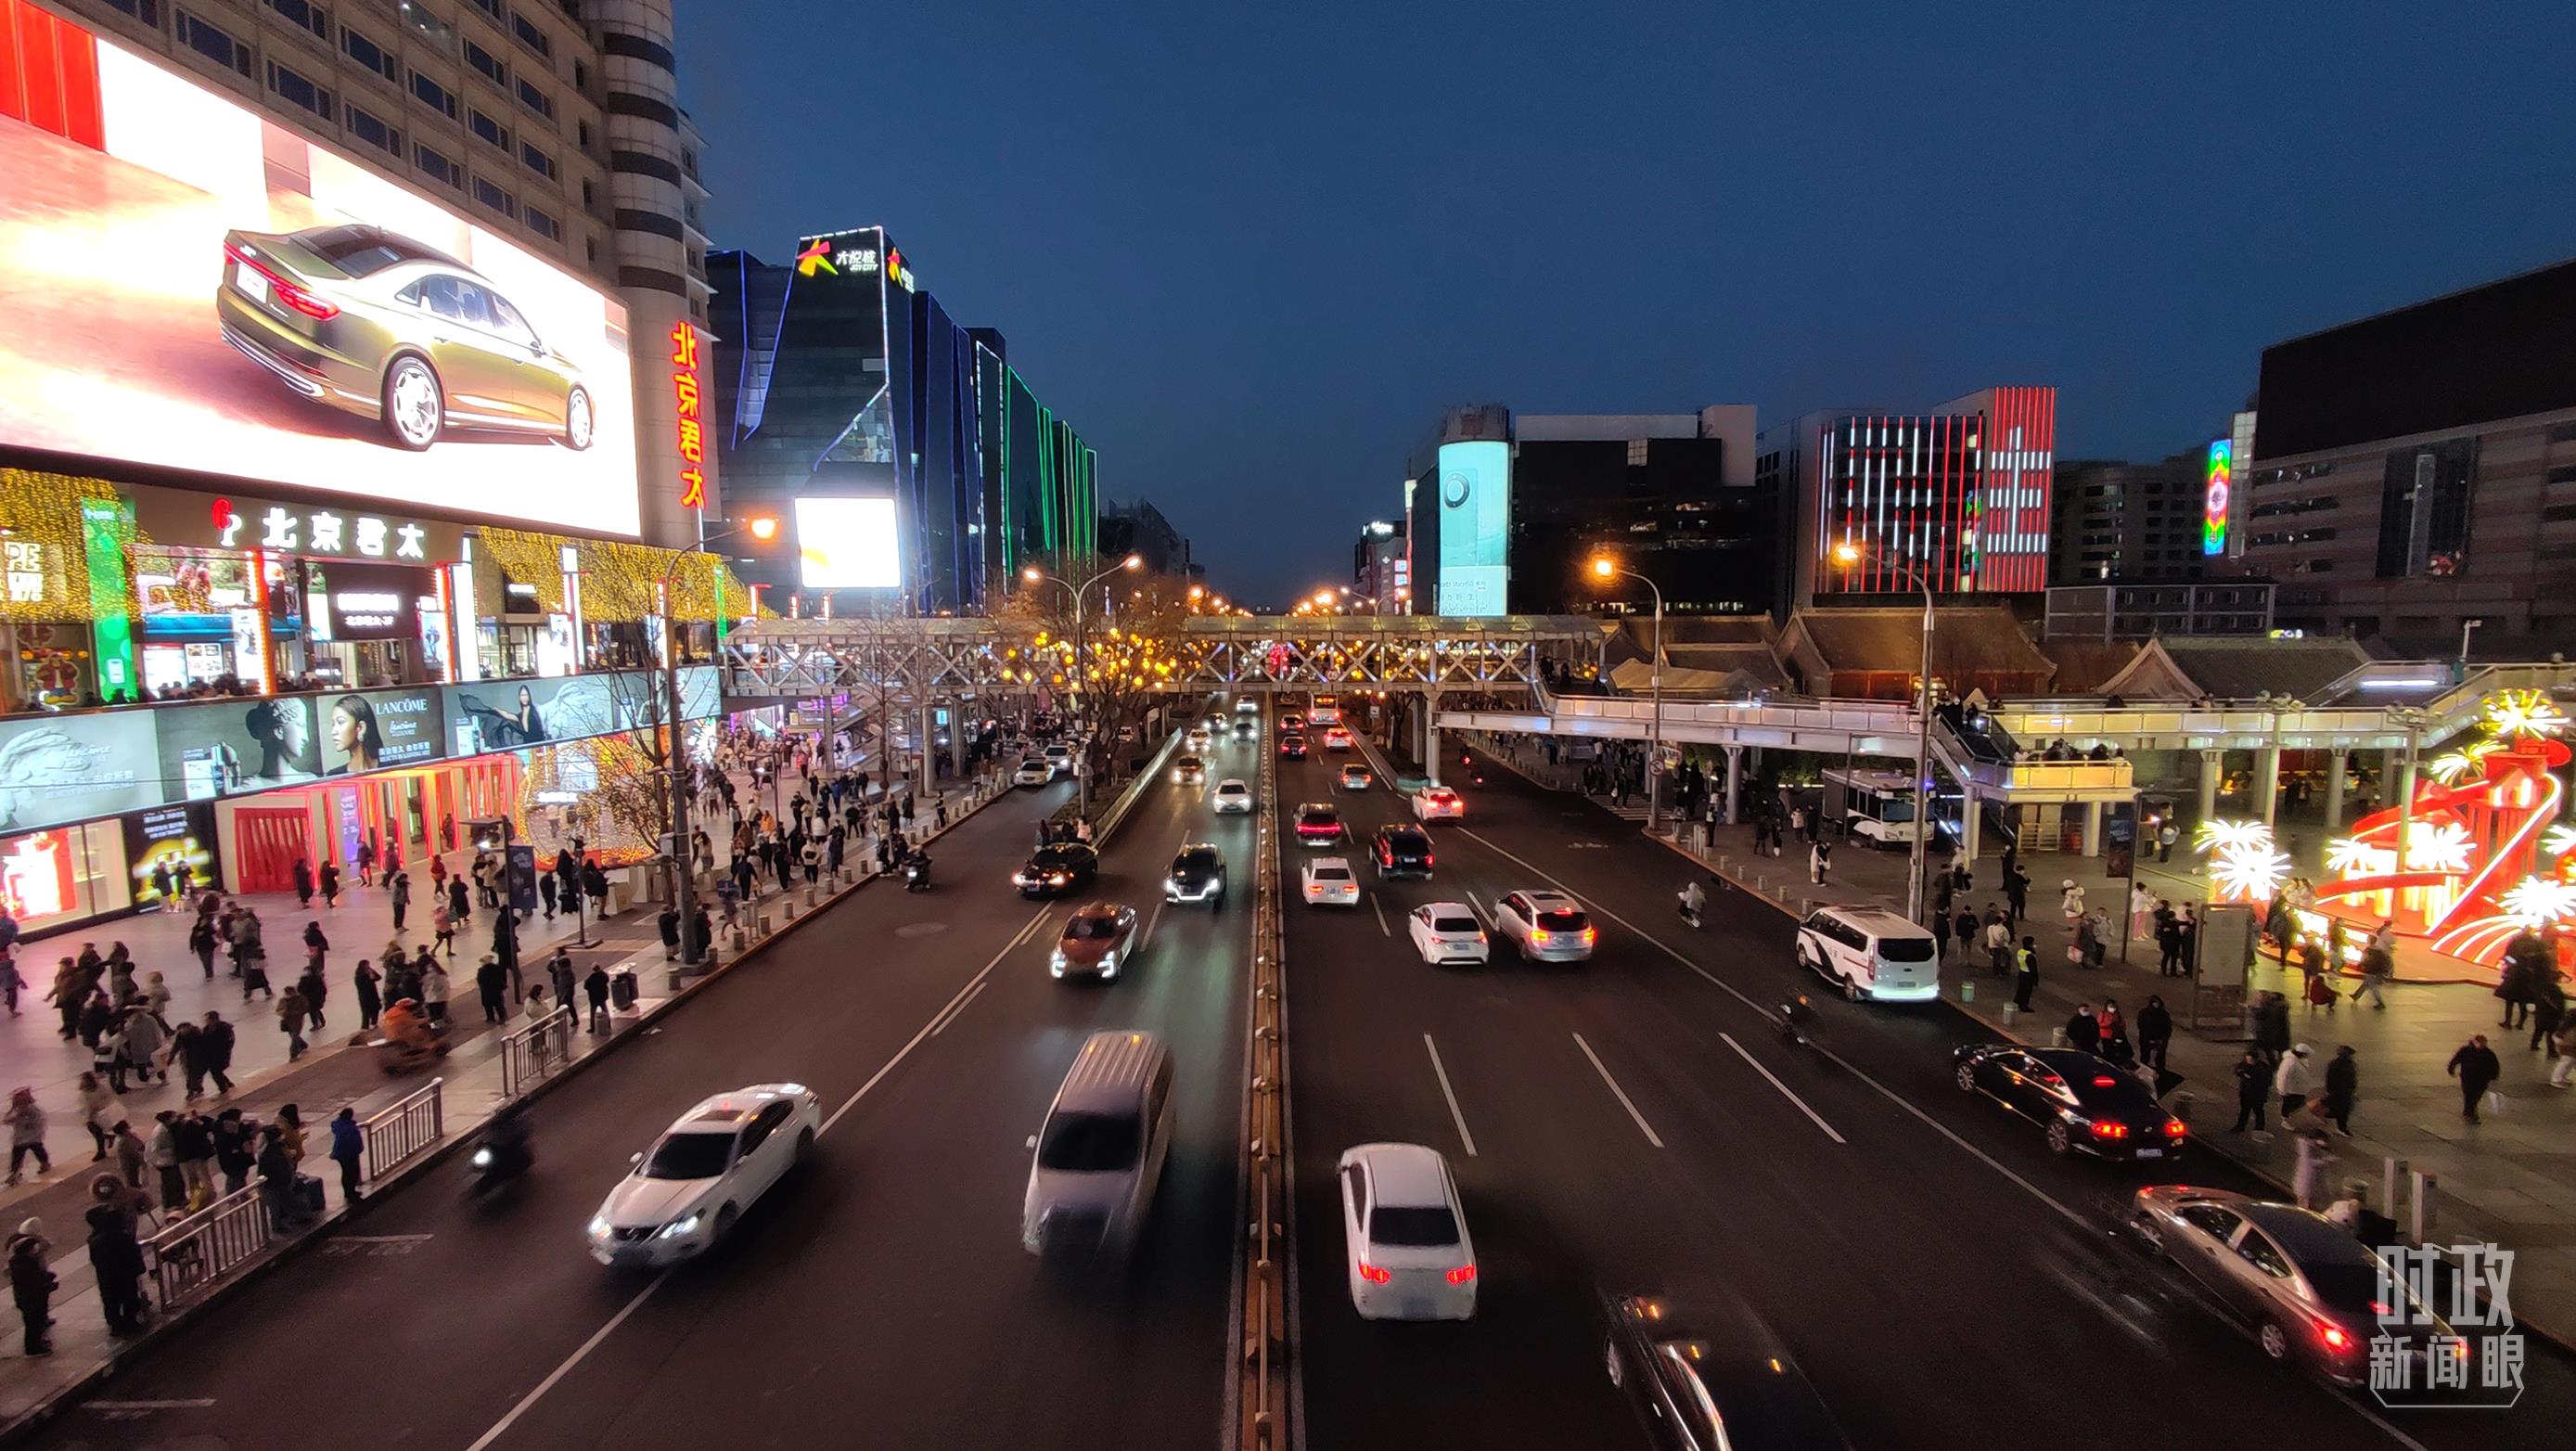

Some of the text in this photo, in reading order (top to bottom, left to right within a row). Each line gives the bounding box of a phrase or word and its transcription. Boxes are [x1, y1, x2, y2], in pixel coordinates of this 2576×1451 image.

[836, 250, 877, 265] 大悦城
[671, 319, 706, 508] 北京君太
[262, 507, 425, 559] 北京君太
[375, 698, 428, 715] LANCÔME
